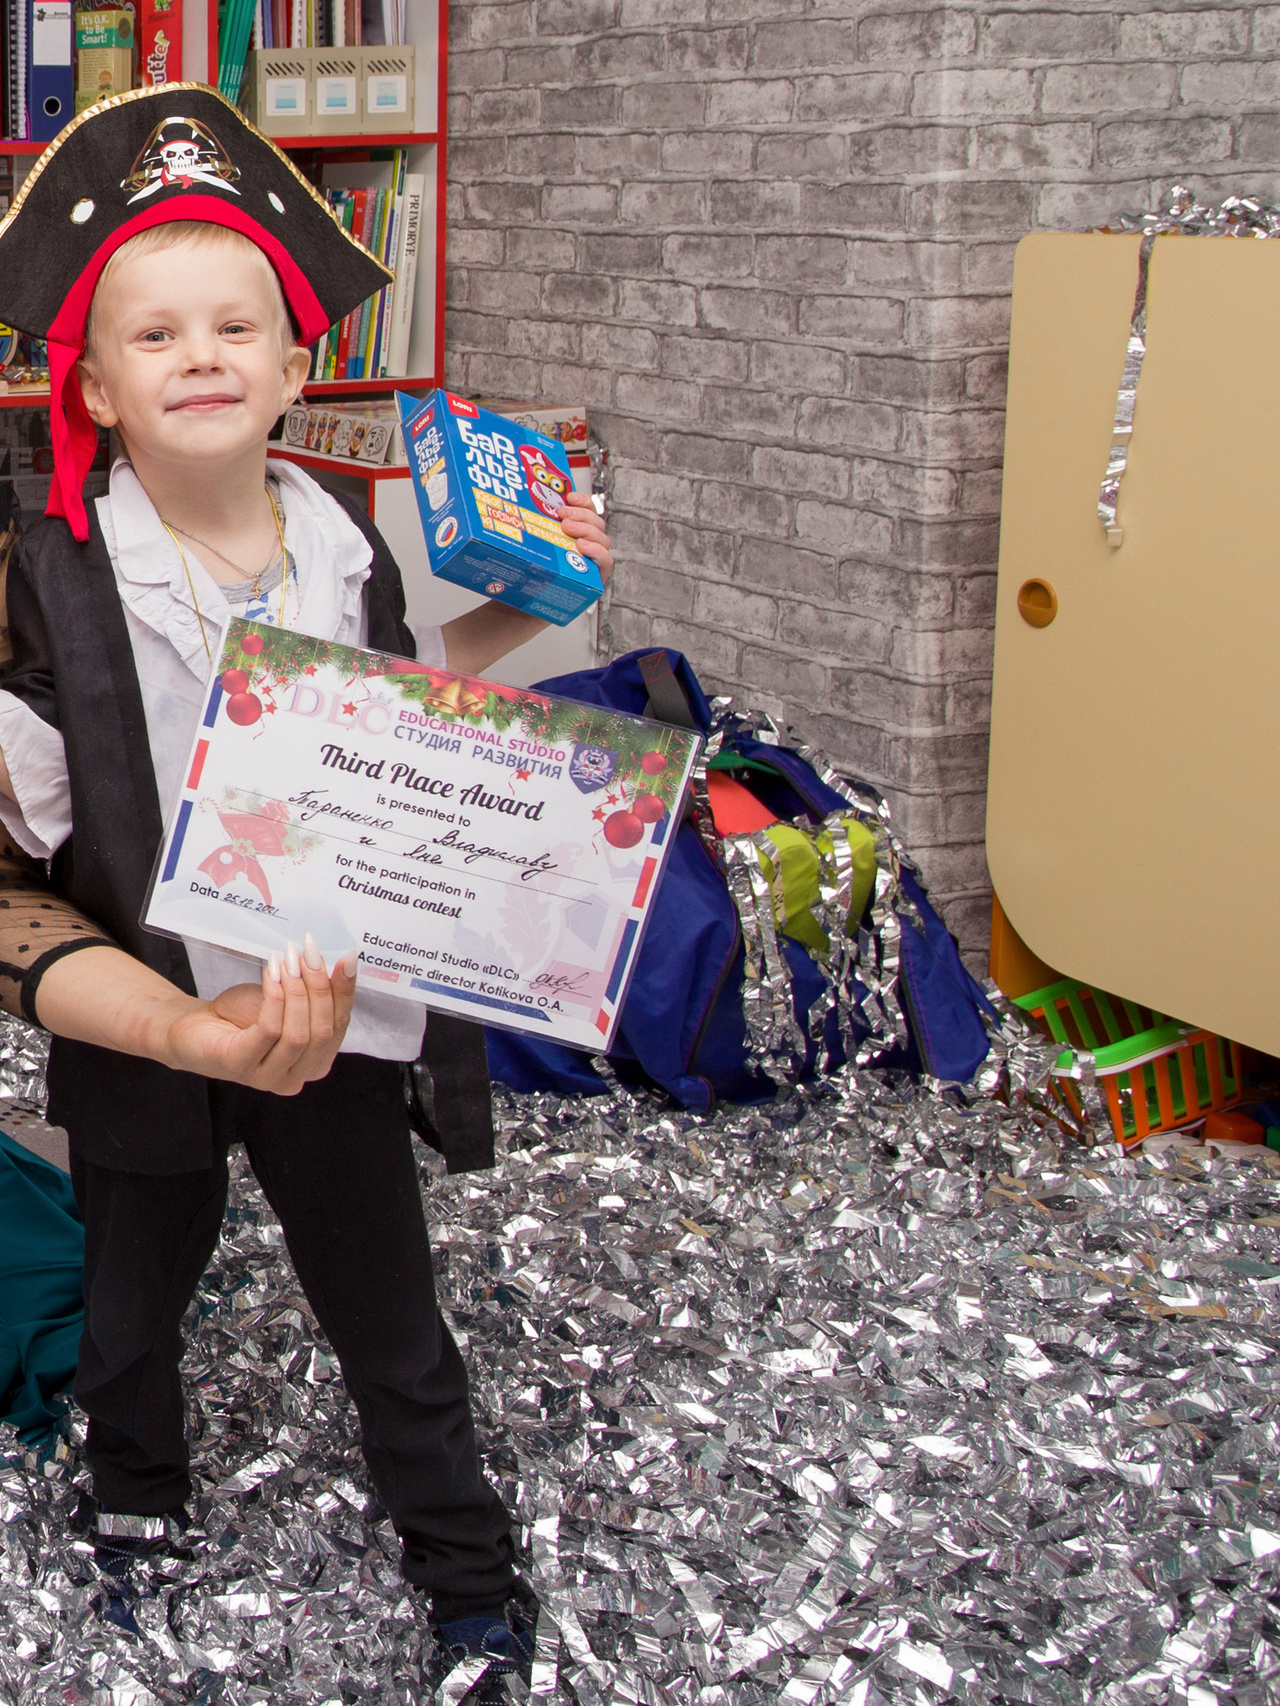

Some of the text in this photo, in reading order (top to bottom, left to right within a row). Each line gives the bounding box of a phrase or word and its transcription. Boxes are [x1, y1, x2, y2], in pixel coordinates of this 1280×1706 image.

[81, 15, 93, 25] It's
[94, 14, 110, 24] O.K.
[82, 33, 108, 44] Smart!
[86, 24, 106, 34] to Be
[404, 194, 420, 257] PRIMORYE
[414, 415, 430, 432] LORI
[452, 400, 472, 413] LORI
[394, 725, 563, 780] СТУДИЯ РАЗВИТИЯ
[398, 710, 566, 762] EDUCATIONAL STUDIO
[320, 743, 546, 821] Third Place Award
[376, 794, 471, 827] is presented to
[190, 882, 220, 899] Data
[336, 854, 476, 900] for the participation in
[338, 874, 462, 920] Christmas contest
[362, 932, 439, 961] Educational
[440, 952, 480, 972] Studio
[482, 964, 520, 982] «DLC»
[358, 951, 424, 977] Academic
[426, 968, 476, 991] director
[478, 982, 534, 1005] Kotikova
[536, 997, 564, 1013] O.A.
